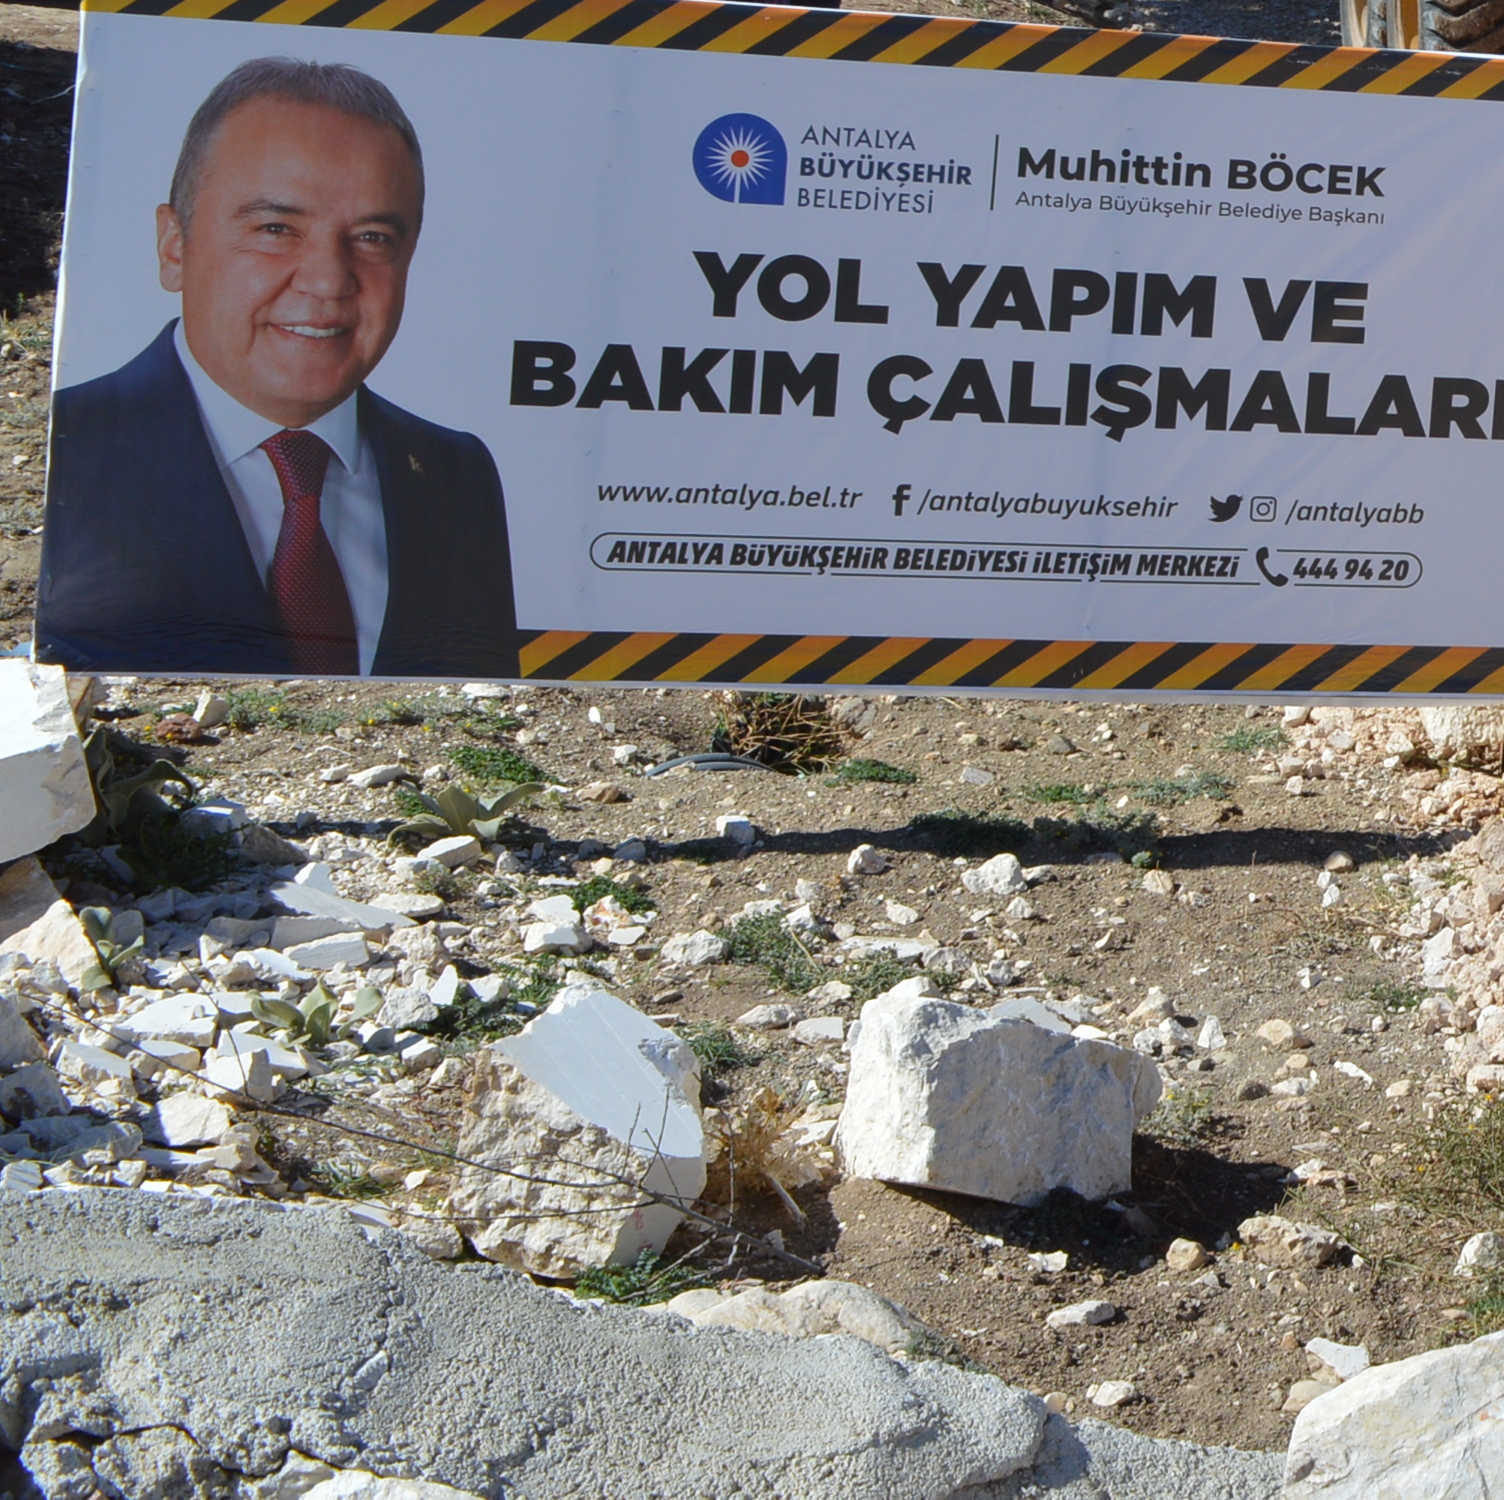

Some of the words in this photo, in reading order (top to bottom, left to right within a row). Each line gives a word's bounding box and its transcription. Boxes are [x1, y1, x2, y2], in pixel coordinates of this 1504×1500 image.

[800, 124, 917, 151] ANTALYA
[799, 151, 973, 188] BÜYÜKŞEHİR
[1016, 146, 1213, 188] Muhittin
[1226, 151, 1387, 198] BÖCEK
[797, 186, 935, 214] BELEDİYESİ
[1015, 190, 1094, 213] Antalya
[1098, 194, 1213, 219] Büyükşehir
[1217, 200, 1303, 224] Belediye
[1308, 205, 1385, 226] Başkanı
[691, 250, 890, 324] YOL
[915, 261, 1218, 339] YAPIM
[1242, 276, 1370, 345] VE
[509, 339, 840, 418] BAKIM
[597, 482, 864, 511] www.antalya.bel.tr
[916, 488, 1179, 521] /antalyabuyuksehir
[1284, 499, 1425, 528] /antalyabb
[606, 540, 725, 566] ANTALYA
[729, 542, 889, 576] BÜYÜKŞEHİR
[892, 547, 1027, 575] BELEDİYESİ
[1031, 550, 1130, 582] İLETİŞİM
[1135, 553, 1240, 578] MERKEZİ
[1292, 556, 1339, 580] 444
[1344, 558, 1374, 581] 94
[1377, 559, 1410, 582] 20
